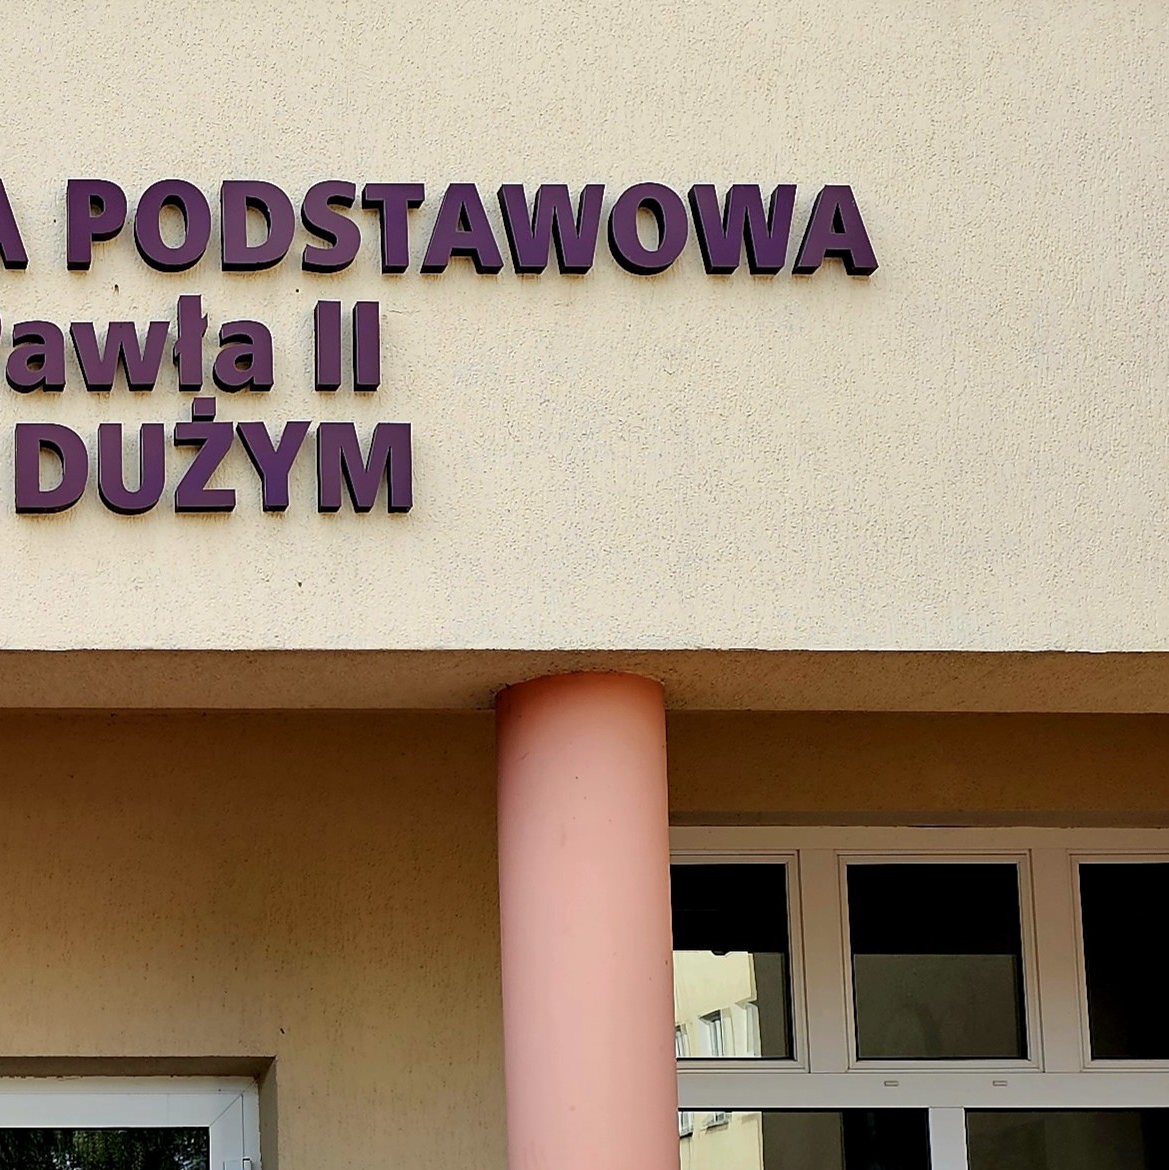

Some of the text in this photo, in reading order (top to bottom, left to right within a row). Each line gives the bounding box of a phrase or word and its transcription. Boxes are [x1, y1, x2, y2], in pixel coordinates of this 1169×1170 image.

[66, 178, 879, 279] PODSTAWOWA
[313, 300, 381, 393] II
[14, 396, 414, 518] DUŻYM
